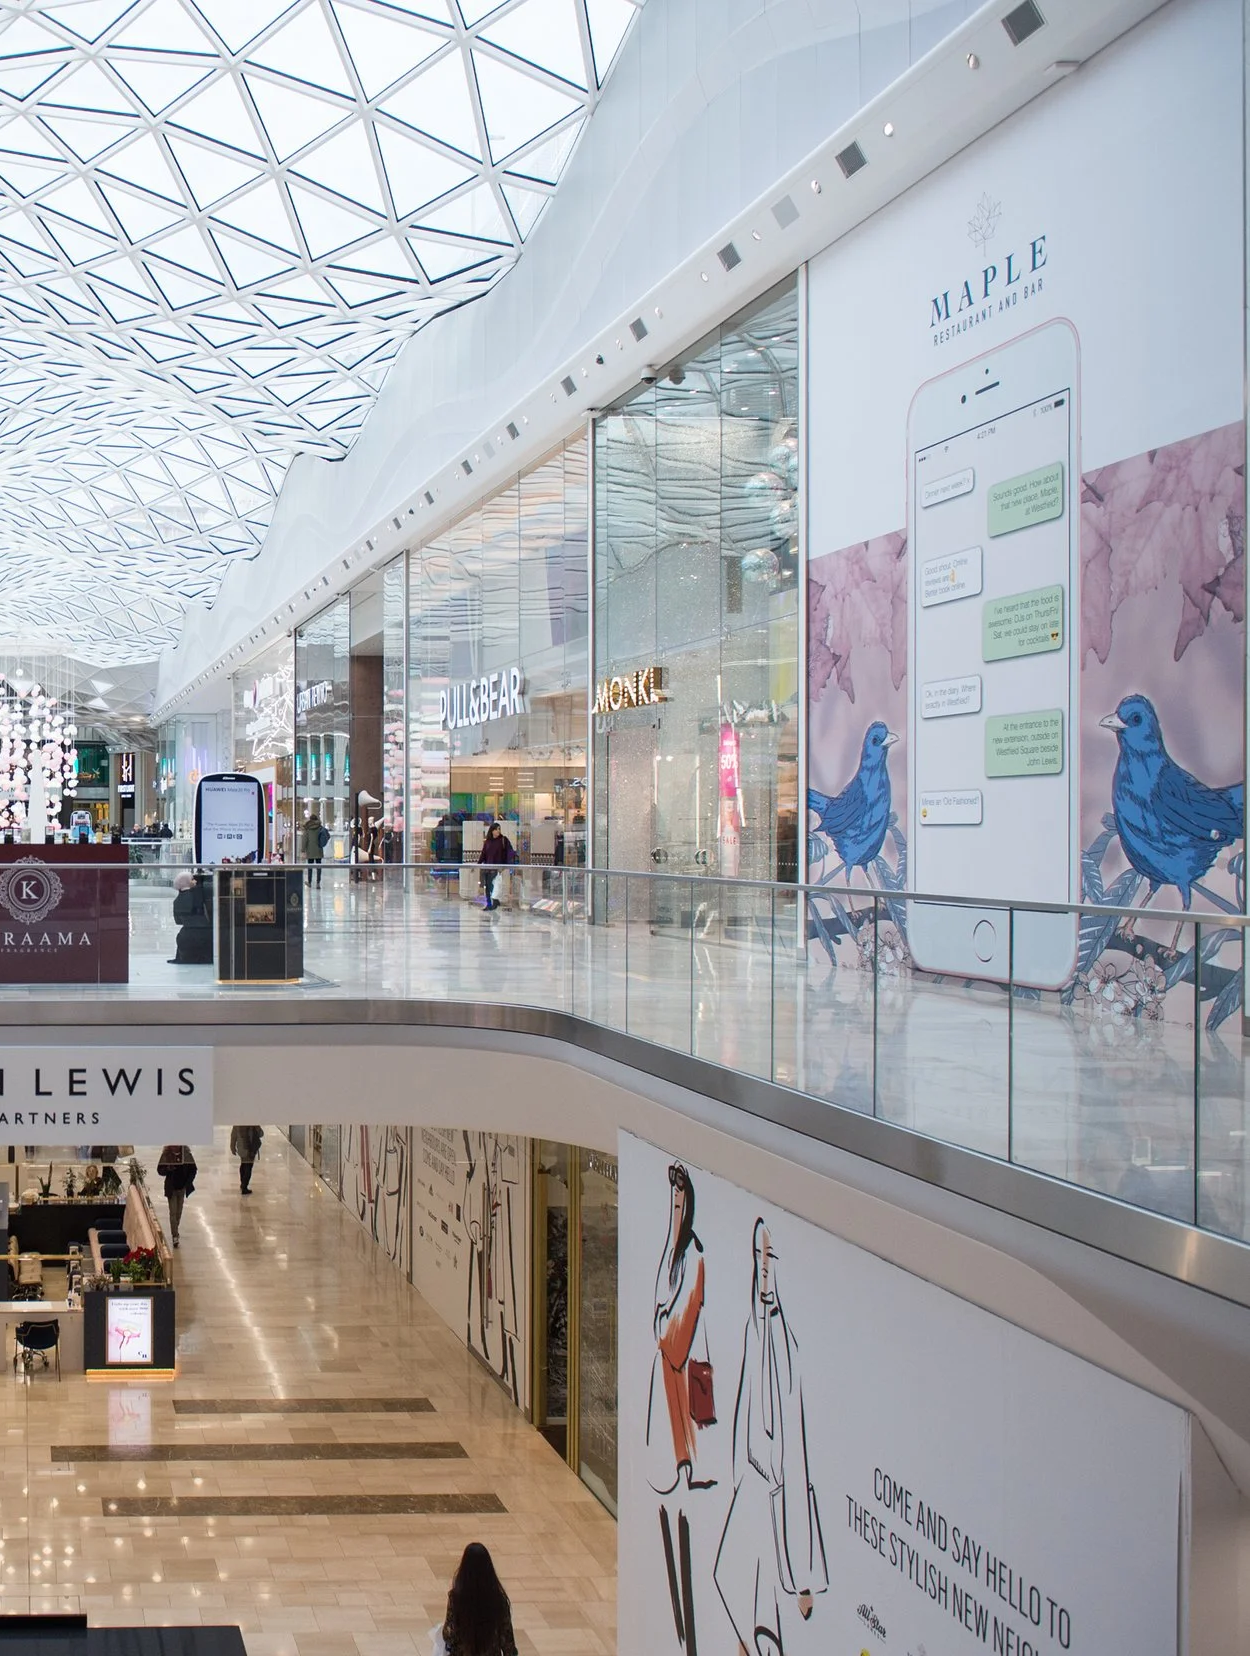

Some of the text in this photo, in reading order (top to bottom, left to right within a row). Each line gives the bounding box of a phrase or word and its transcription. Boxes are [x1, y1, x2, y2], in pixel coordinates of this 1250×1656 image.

[930, 235, 1048, 328] MAPLE
[933, 278, 1043, 347] RESTAURANT AND BAR
[993, 488, 1012, 502] Sounds
[1029, 480, 1041, 489] How
[1043, 472, 1059, 482] about
[1000, 501, 1010, 511] that
[1012, 498, 1022, 507] new
[1004, 603, 1019, 613] heard
[1020, 600, 1030, 609] that
[1031, 598, 1039, 608] the
[1040, 595, 1053, 604] food
[1026, 613, 1033, 621] on
[1013, 626, 1028, 636] could
[1029, 624, 1039, 634] stay
[1041, 622, 1048, 630] on
[1026, 634, 1050, 645] cocktails
[594, 667, 657, 713] MONKI
[439, 667, 521, 731] PULL&BEAR
[1003, 719, 1059, 731] At the entrance to the
[1030, 732, 1050, 741] outside
[996, 744, 1059, 756] Westfield Square beside
[720, 754, 739, 770] 50%
[1027, 757, 1040, 767] John
[722, 835, 738, 846] SALE
[20, 881, 38, 899] K
[34, 1068, 196, 1097] LEWIS
[874, 1468, 1071, 1650] COME AND SAY HELLO TO
[846, 1494, 886, 1557] THESE
[890, 1532, 948, 1611] STYLISH
[953, 1583, 988, 1643] NEW
